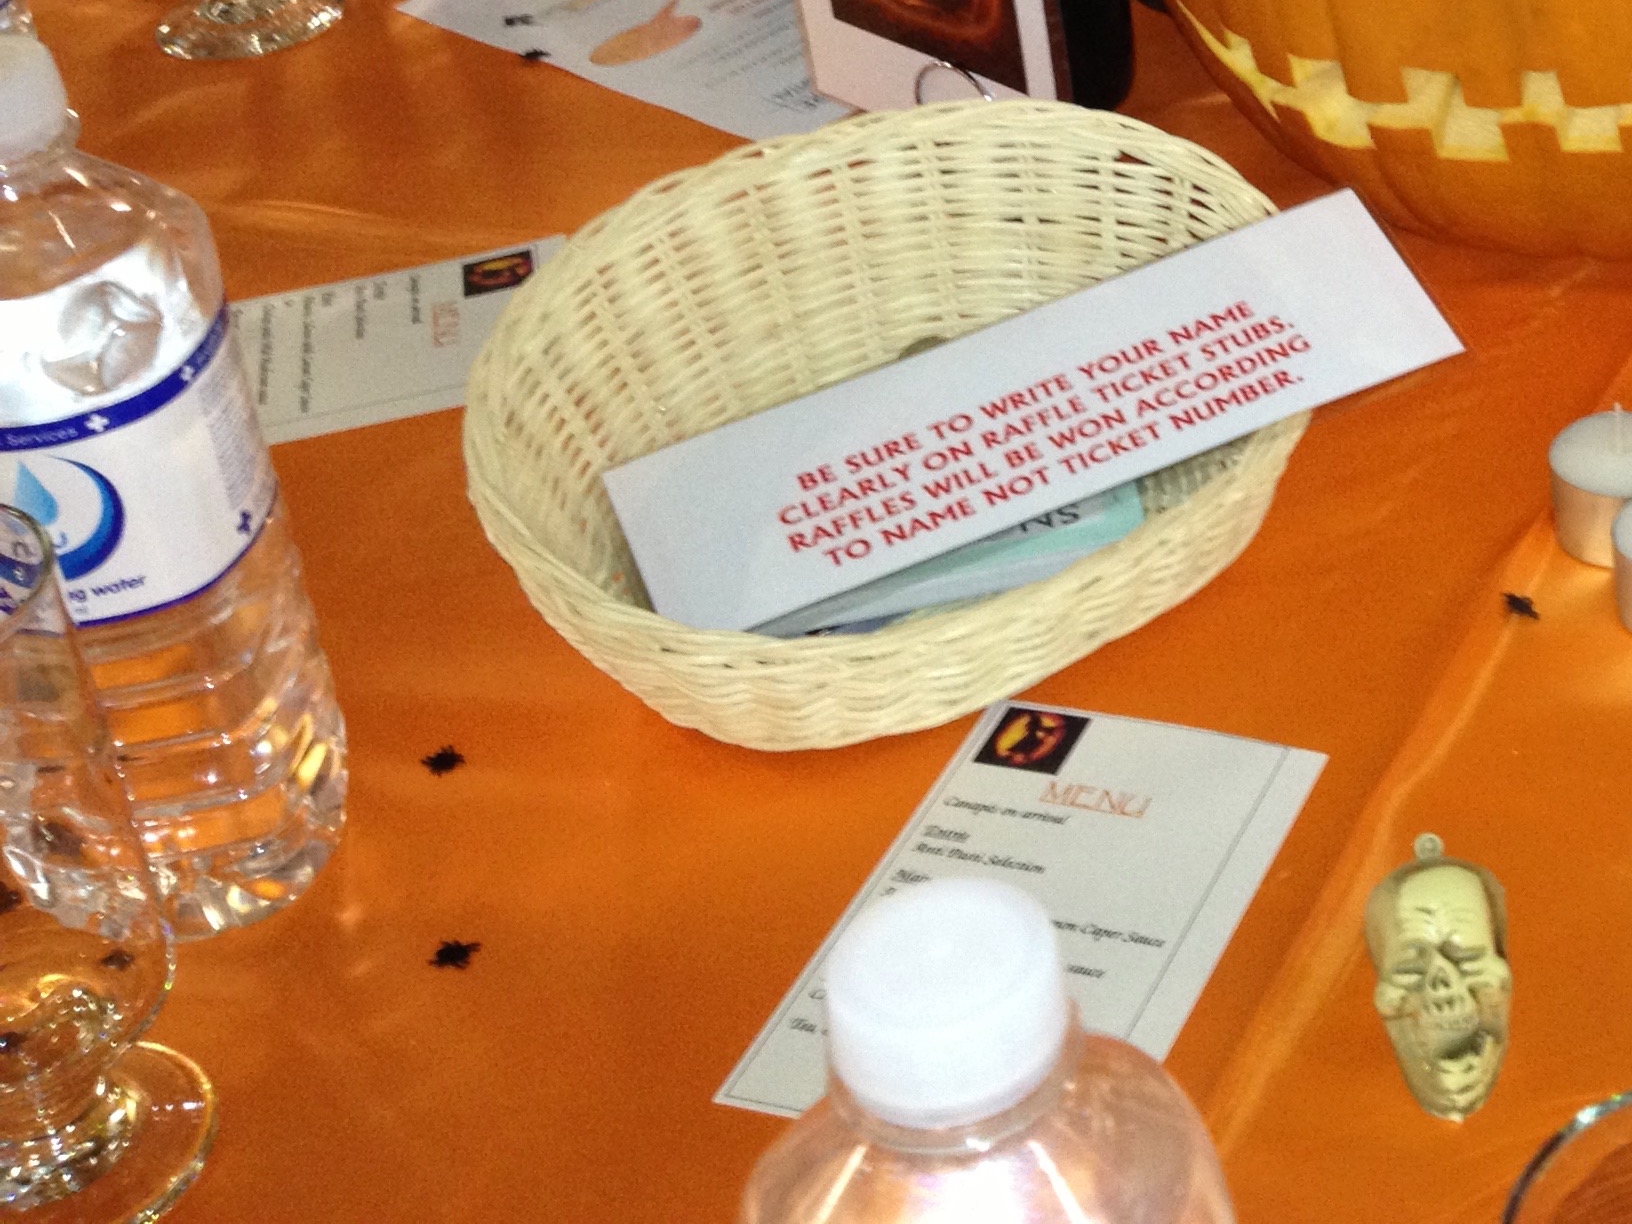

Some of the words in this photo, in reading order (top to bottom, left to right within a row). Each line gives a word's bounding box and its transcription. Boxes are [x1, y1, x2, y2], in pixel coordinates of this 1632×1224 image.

[778, 463, 912, 526] CLEARLY
[922, 441, 974, 472] ON
[979, 394, 1087, 450] RAFFLE
[1091, 351, 1192, 404] TICKET
[1200, 315, 1295, 362] STUBS.
[787, 490, 918, 552] RAFFLES
[921, 462, 998, 499] WILL
[1004, 442, 1044, 469] BE
[1048, 409, 1127, 450] WON
[1136, 334, 1312, 418] ACCORDING
[797, 464, 838, 492] BE
[844, 432, 923, 474] SURE
[928, 413, 974, 440] TO
[979, 373, 1073, 420] WRITE
[1078, 338, 1164, 381] YOUR
[1167, 300, 1256, 345] NAME
[823, 538, 873, 567] TO
[879, 497, 977, 547] NAME
[981, 466, 1050, 507] NOT
[1057, 421, 1161, 475] TICKET
[1167, 369, 1304, 432] NUMBER.
[93, 576, 147, 598] water
[1039, 780, 1153, 820] MENU
